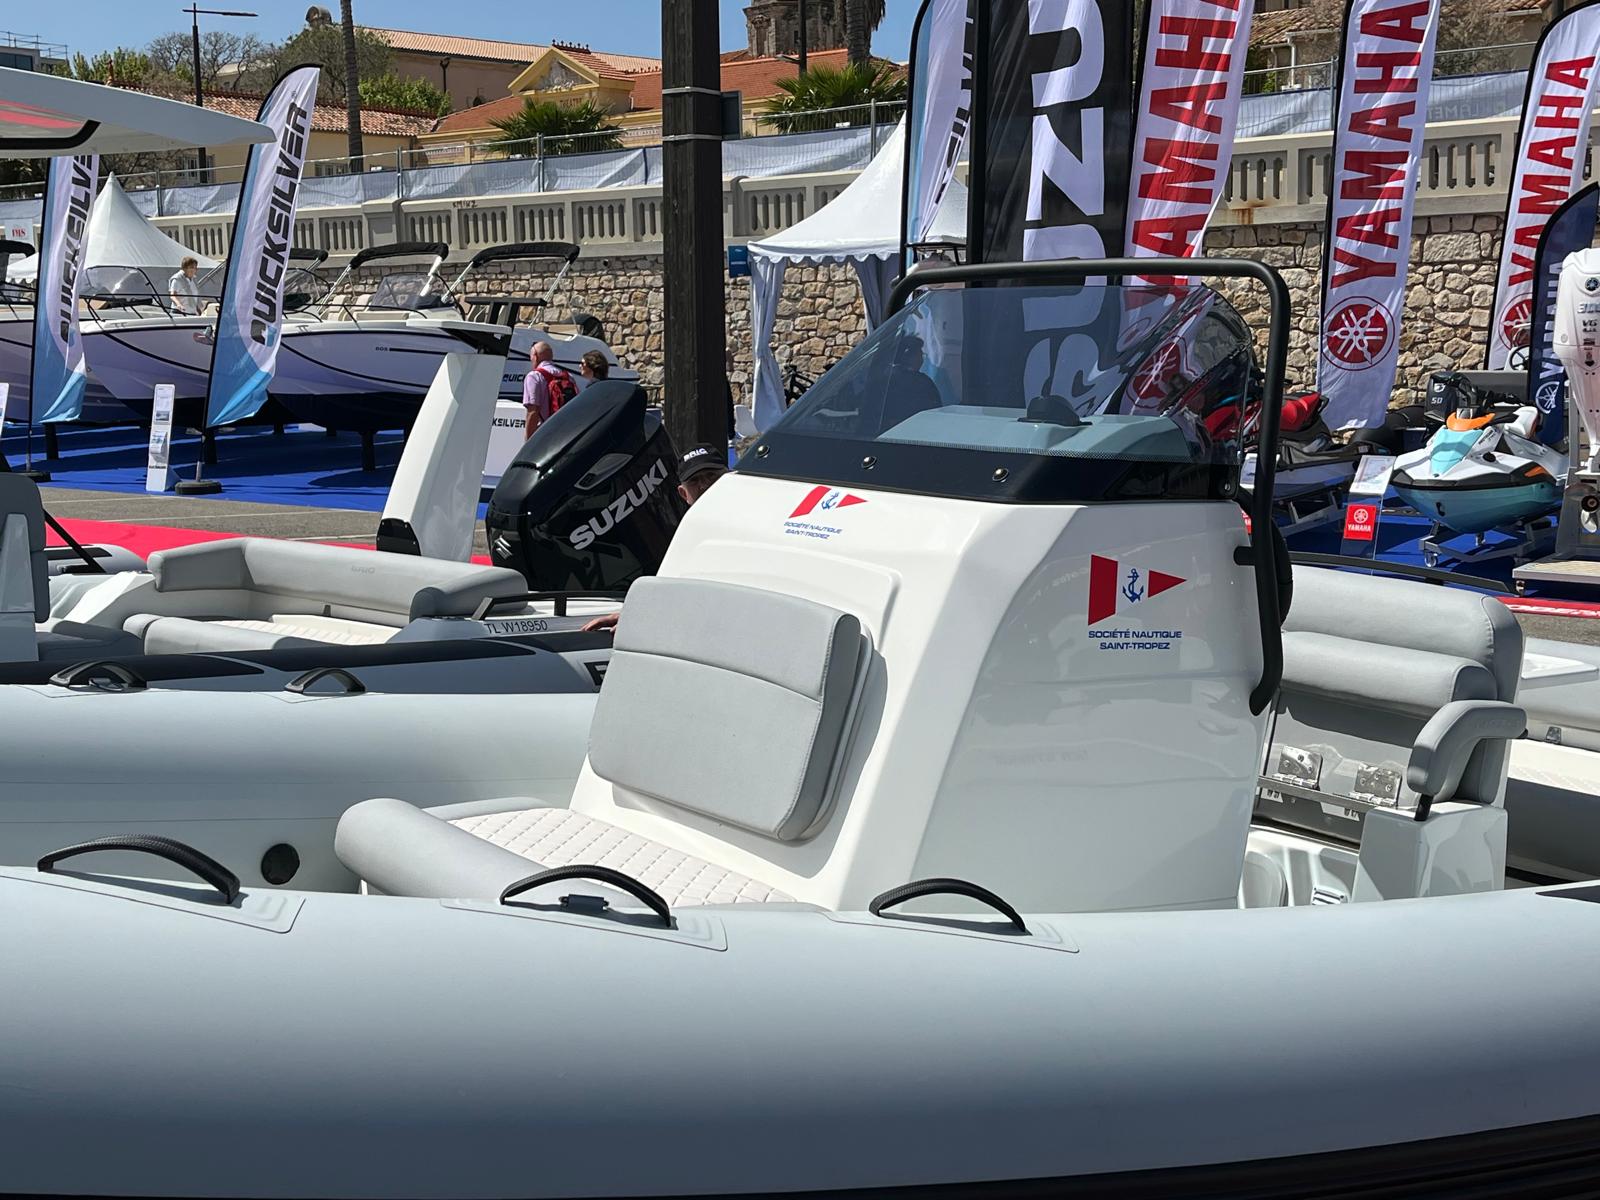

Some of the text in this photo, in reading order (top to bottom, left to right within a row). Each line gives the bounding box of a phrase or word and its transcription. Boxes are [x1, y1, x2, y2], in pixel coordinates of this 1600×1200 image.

[1124, 0, 1239, 311] YAMAH
[1330, 0, 1430, 289] YAMAHA
[251, 101, 307, 347] QUICKSILVER
[569, 458, 669, 551] SUZUKI
[1347, 524, 1372, 532] YAMAHA
[484, 620, 548, 634] TL W18950
[1088, 628, 1182, 639] SOCIÉTÉ NAUTIQUE
[1100, 642, 1170, 650] SAINT-TROPEZ
